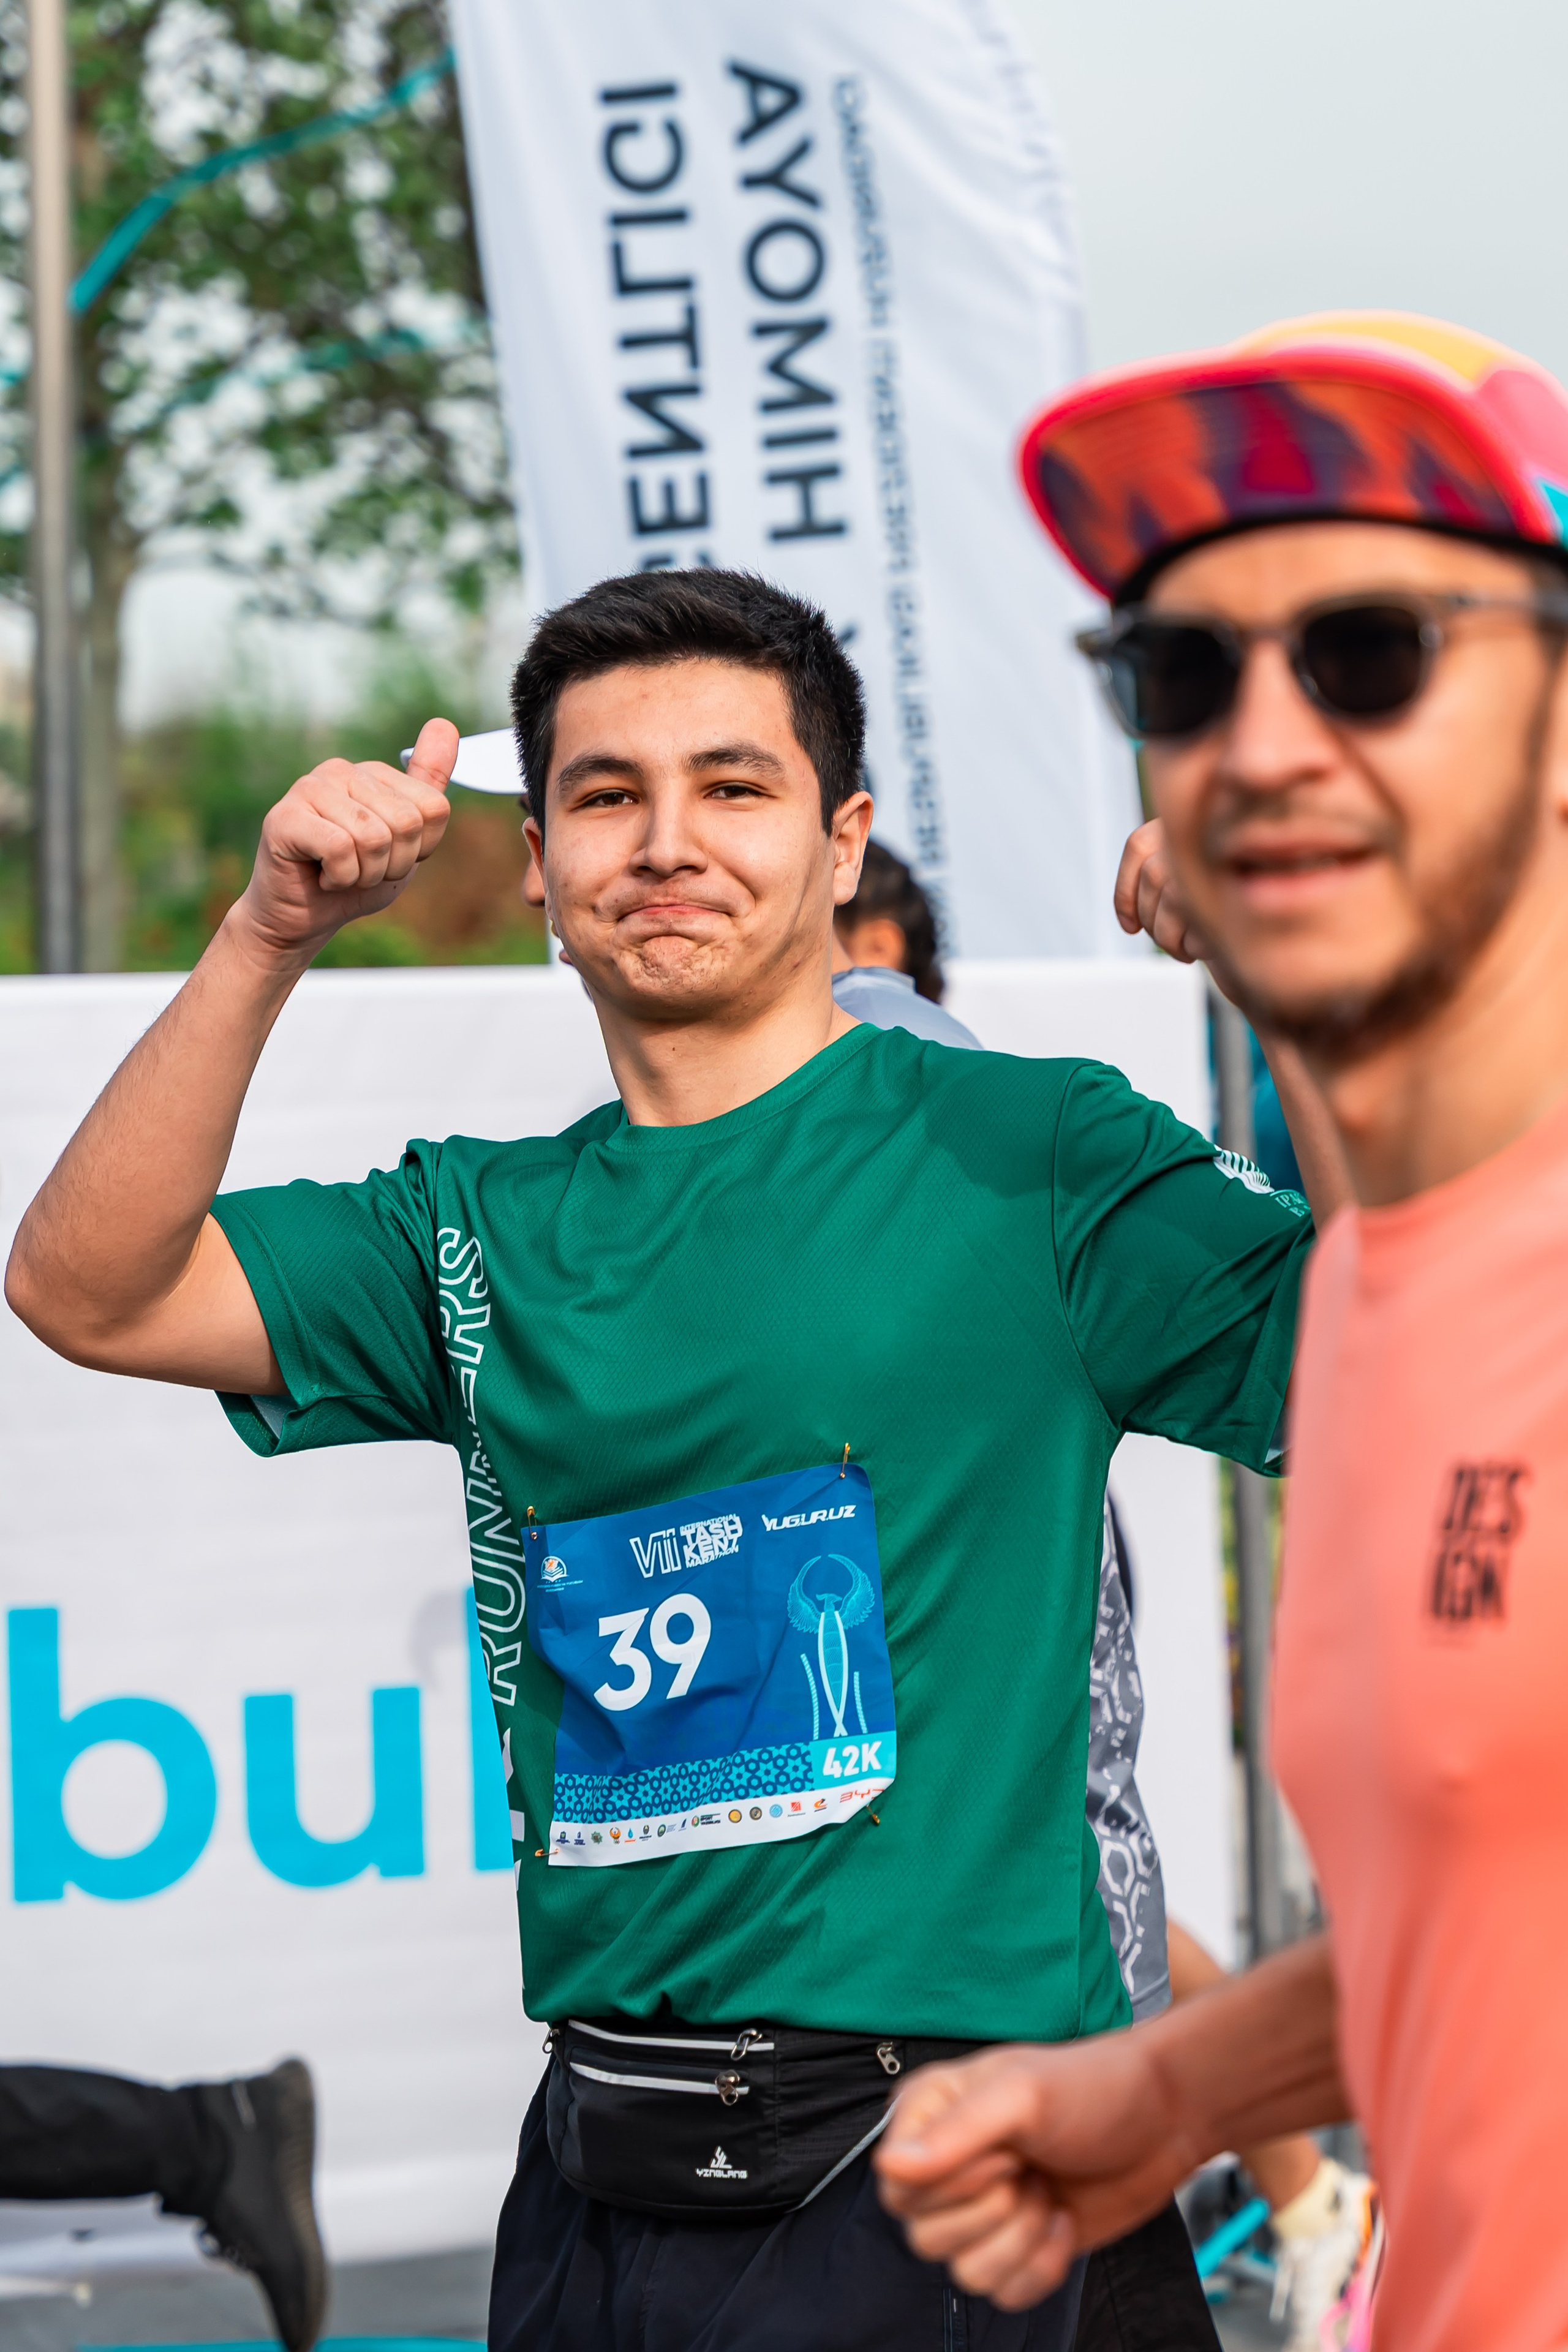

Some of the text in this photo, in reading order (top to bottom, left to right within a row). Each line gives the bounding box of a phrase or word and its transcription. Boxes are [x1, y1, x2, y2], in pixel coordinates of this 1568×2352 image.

[680, 1513, 736, 1533] INTERNATIONAL
[685, 1544, 739, 1569] MARATHON
[594, 1593, 711, 1711] 39
[823, 1740, 882, 1779] 42K
